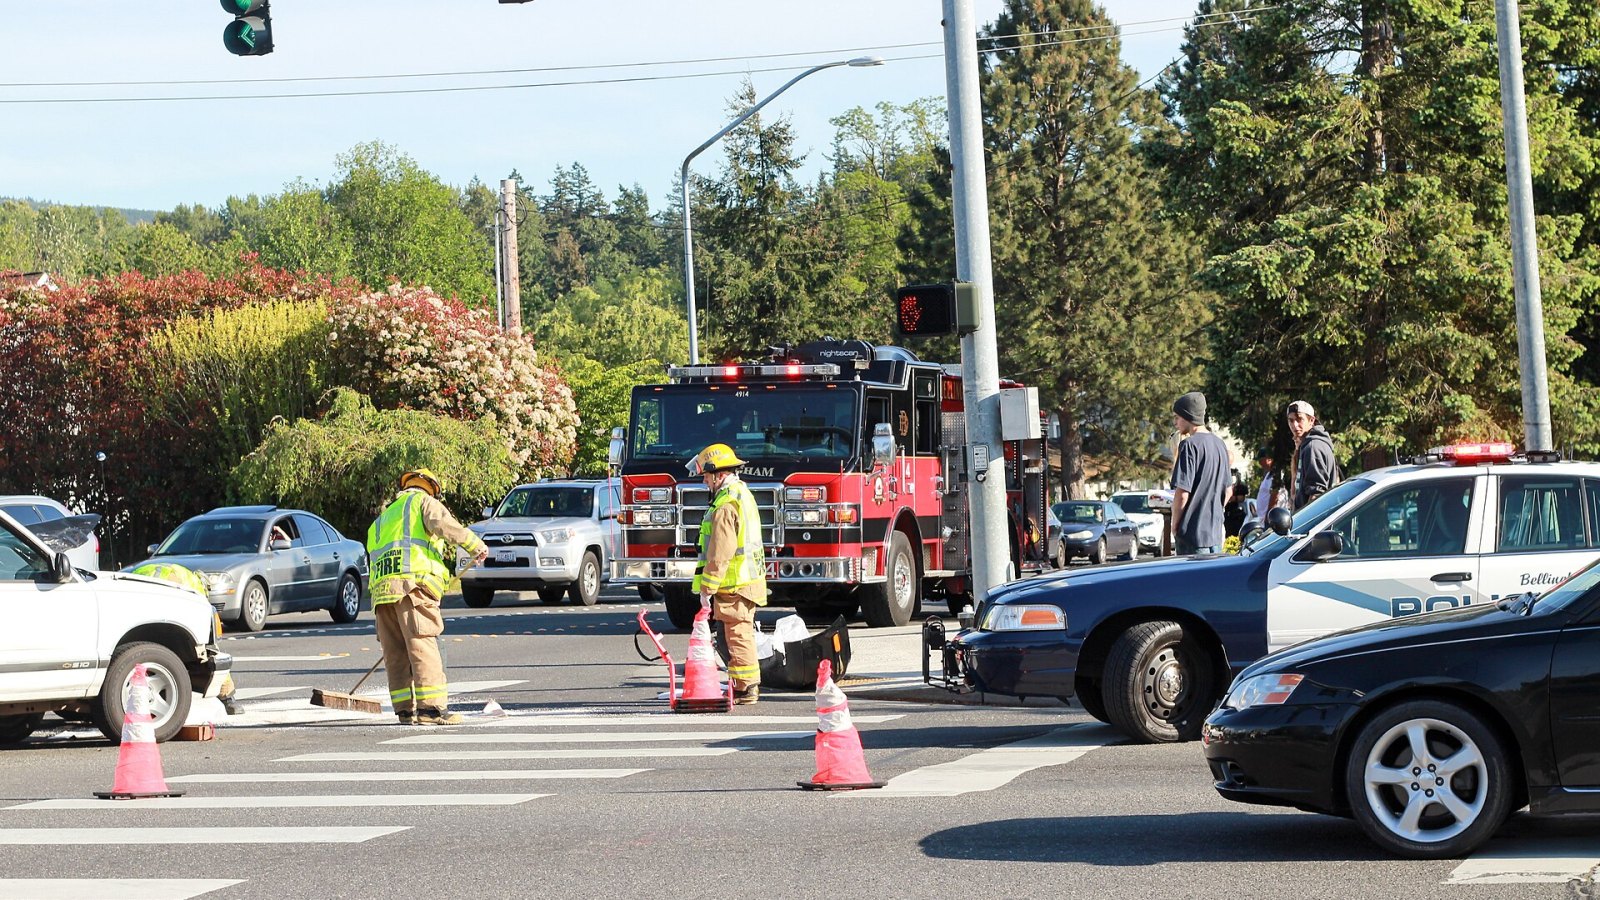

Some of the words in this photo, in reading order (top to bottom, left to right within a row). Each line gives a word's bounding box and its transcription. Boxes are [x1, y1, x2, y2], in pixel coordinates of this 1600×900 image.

[905, 463, 911, 478] 4
[375, 557, 401, 579] FIRE
[766, 563, 777, 578] 4
